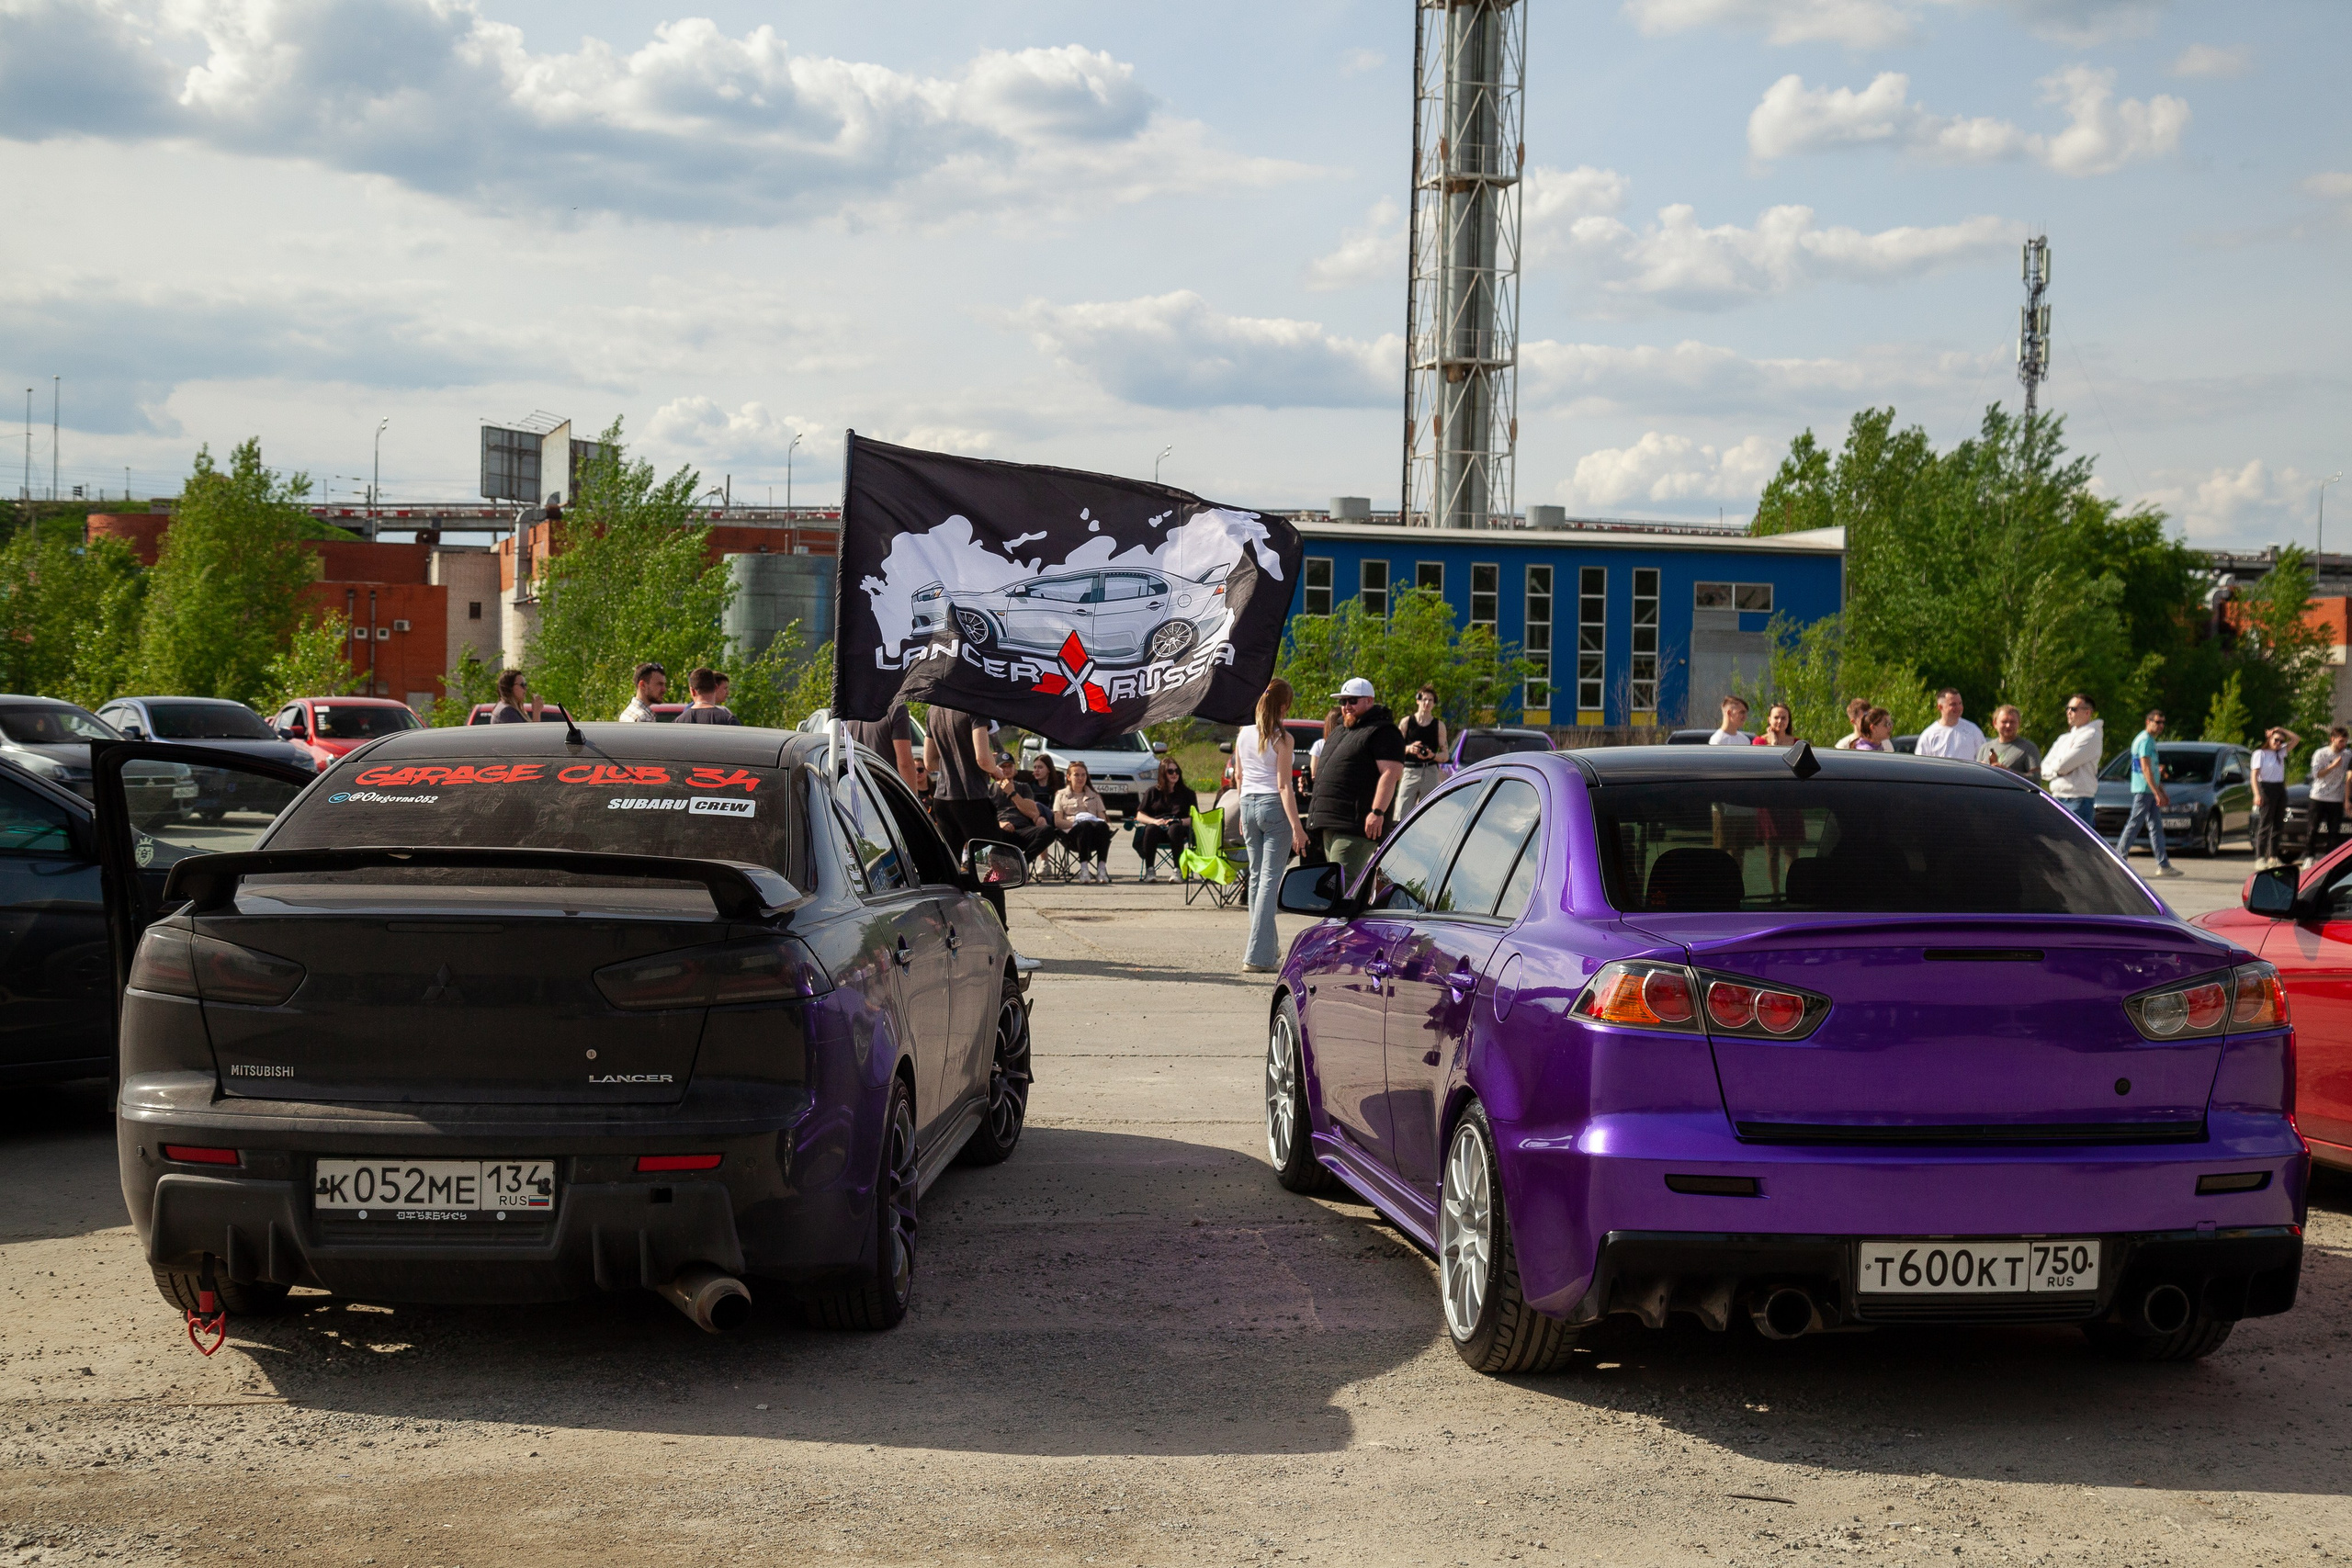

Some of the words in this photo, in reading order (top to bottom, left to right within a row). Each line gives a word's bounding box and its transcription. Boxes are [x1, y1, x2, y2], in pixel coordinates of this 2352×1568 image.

[875, 638, 1041, 683] LANCER
[355, 763, 547, 787] GARAGE
[557, 765, 672, 786] CLUB
[685, 767, 762, 793] 34
[348, 791, 439, 804] @Olegovna052
[607, 797, 691, 812] SUBARU
[694, 799, 751, 814] CREW
[231, 1064, 295, 1078] MITSUBISHI
[587, 1073, 674, 1084] LANCER
[486, 1164, 546, 1194] 134
[499, 1194, 527, 1206] RUS
[2033, 1246, 2088, 1277] 750
[2047, 1276, 2075, 1288] RUS
